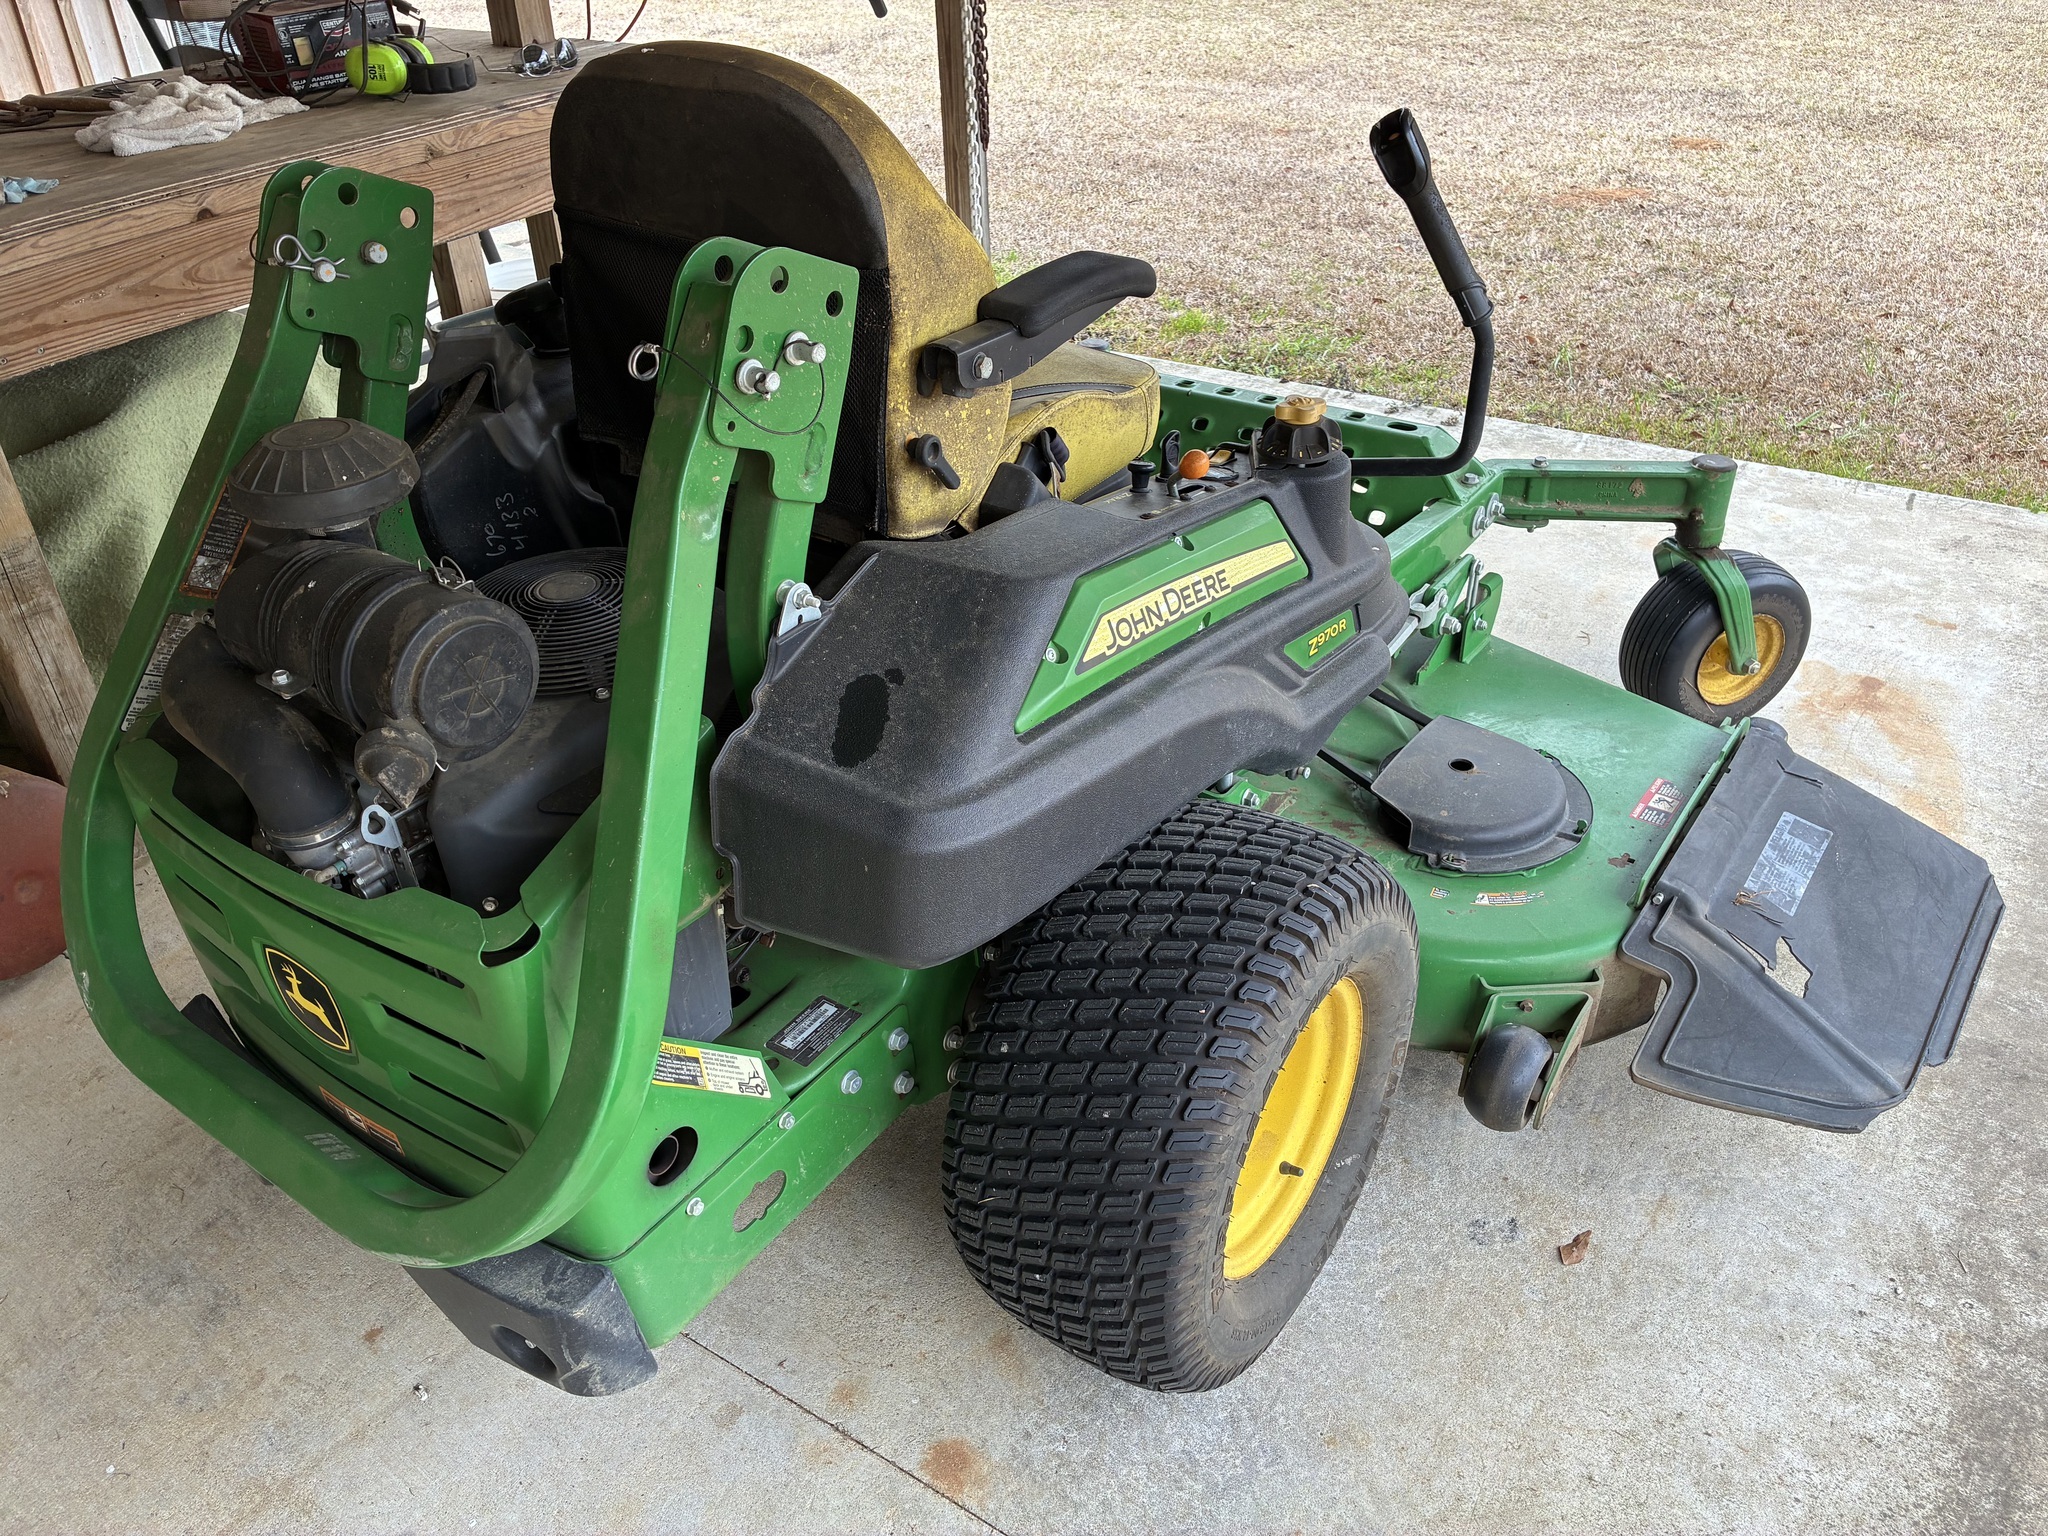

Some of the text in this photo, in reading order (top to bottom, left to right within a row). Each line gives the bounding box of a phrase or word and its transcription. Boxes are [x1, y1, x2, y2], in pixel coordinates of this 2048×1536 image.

[368, 64, 378, 80] 105
[292, 79, 307, 87] DUA
[1106, 569, 1231, 651] JOHN DEERE
[1308, 618, 1347, 657] Z970R
[660, 1043, 687, 1055] CAUTION
